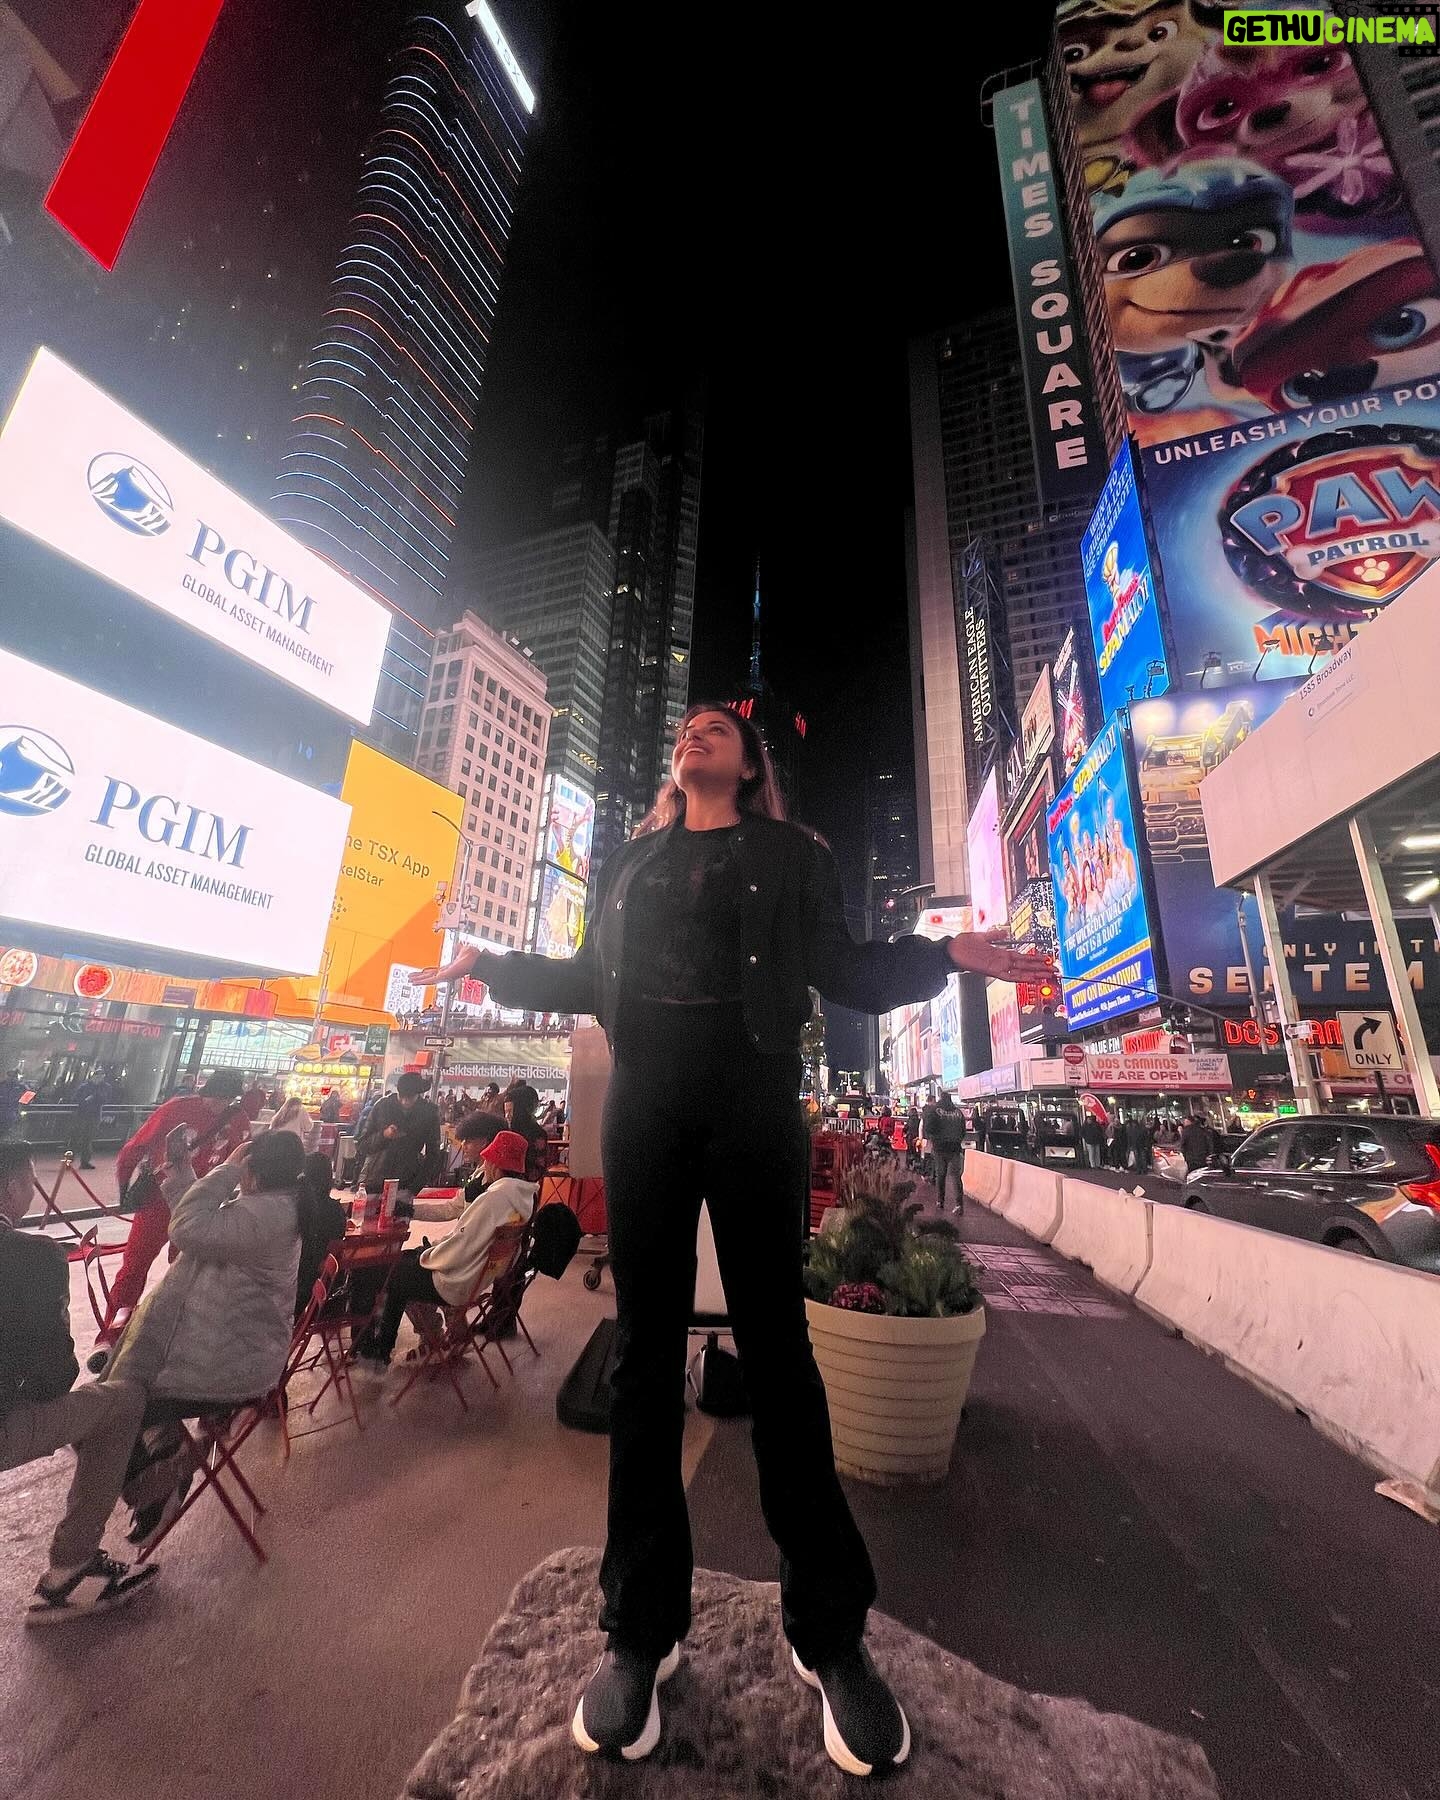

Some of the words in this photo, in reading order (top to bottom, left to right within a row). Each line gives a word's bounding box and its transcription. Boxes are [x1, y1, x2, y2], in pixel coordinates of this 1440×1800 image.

[1009, 98, 1055, 239] TIMES
[1030, 260, 1088, 470] SQUARE
[1154, 420, 1288, 466] UNLEASH
[1297, 397, 1382, 428] YOUR
[1393, 384, 1440, 406] PO
[1230, 466, 1440, 557] PAW
[185, 518, 318, 635] PGIM
[1306, 532, 1430, 566] PATROL
[182, 573, 227, 613] GLOBAL
[230, 607, 265, 635] ASSET
[266, 628, 335, 677] MANAGEMENT
[964, 607, 977, 657] EAGLE
[976, 618, 992, 717] OUTFITTERS
[1316, 648, 1352, 686] Broadway
[969, 657, 983, 742] AMERICAN
[90, 775, 254, 869] PGIM
[85, 843, 141, 876] GLOBAL
[145, 861, 190, 888] ASSET
[191, 875, 275, 911] MANAGEMENT
[369, 840, 399, 866] TSX
[402, 855, 430, 879] App
[1098, 961, 1141, 997] BROADWAY
[1108, 1037, 1120, 1053] FIN
[1224, 1019, 1279, 1045] DOS
[1356, 1054, 1392, 1065] ONLY
[1091, 1071, 1113, 1080] WE
[1118, 1071, 1146, 1081] ARE
[1150, 1071, 1188, 1081] OPEN
[1098, 1058, 1120, 1070] DOS
[1124, 1058, 1179, 1070] CAMINOS
